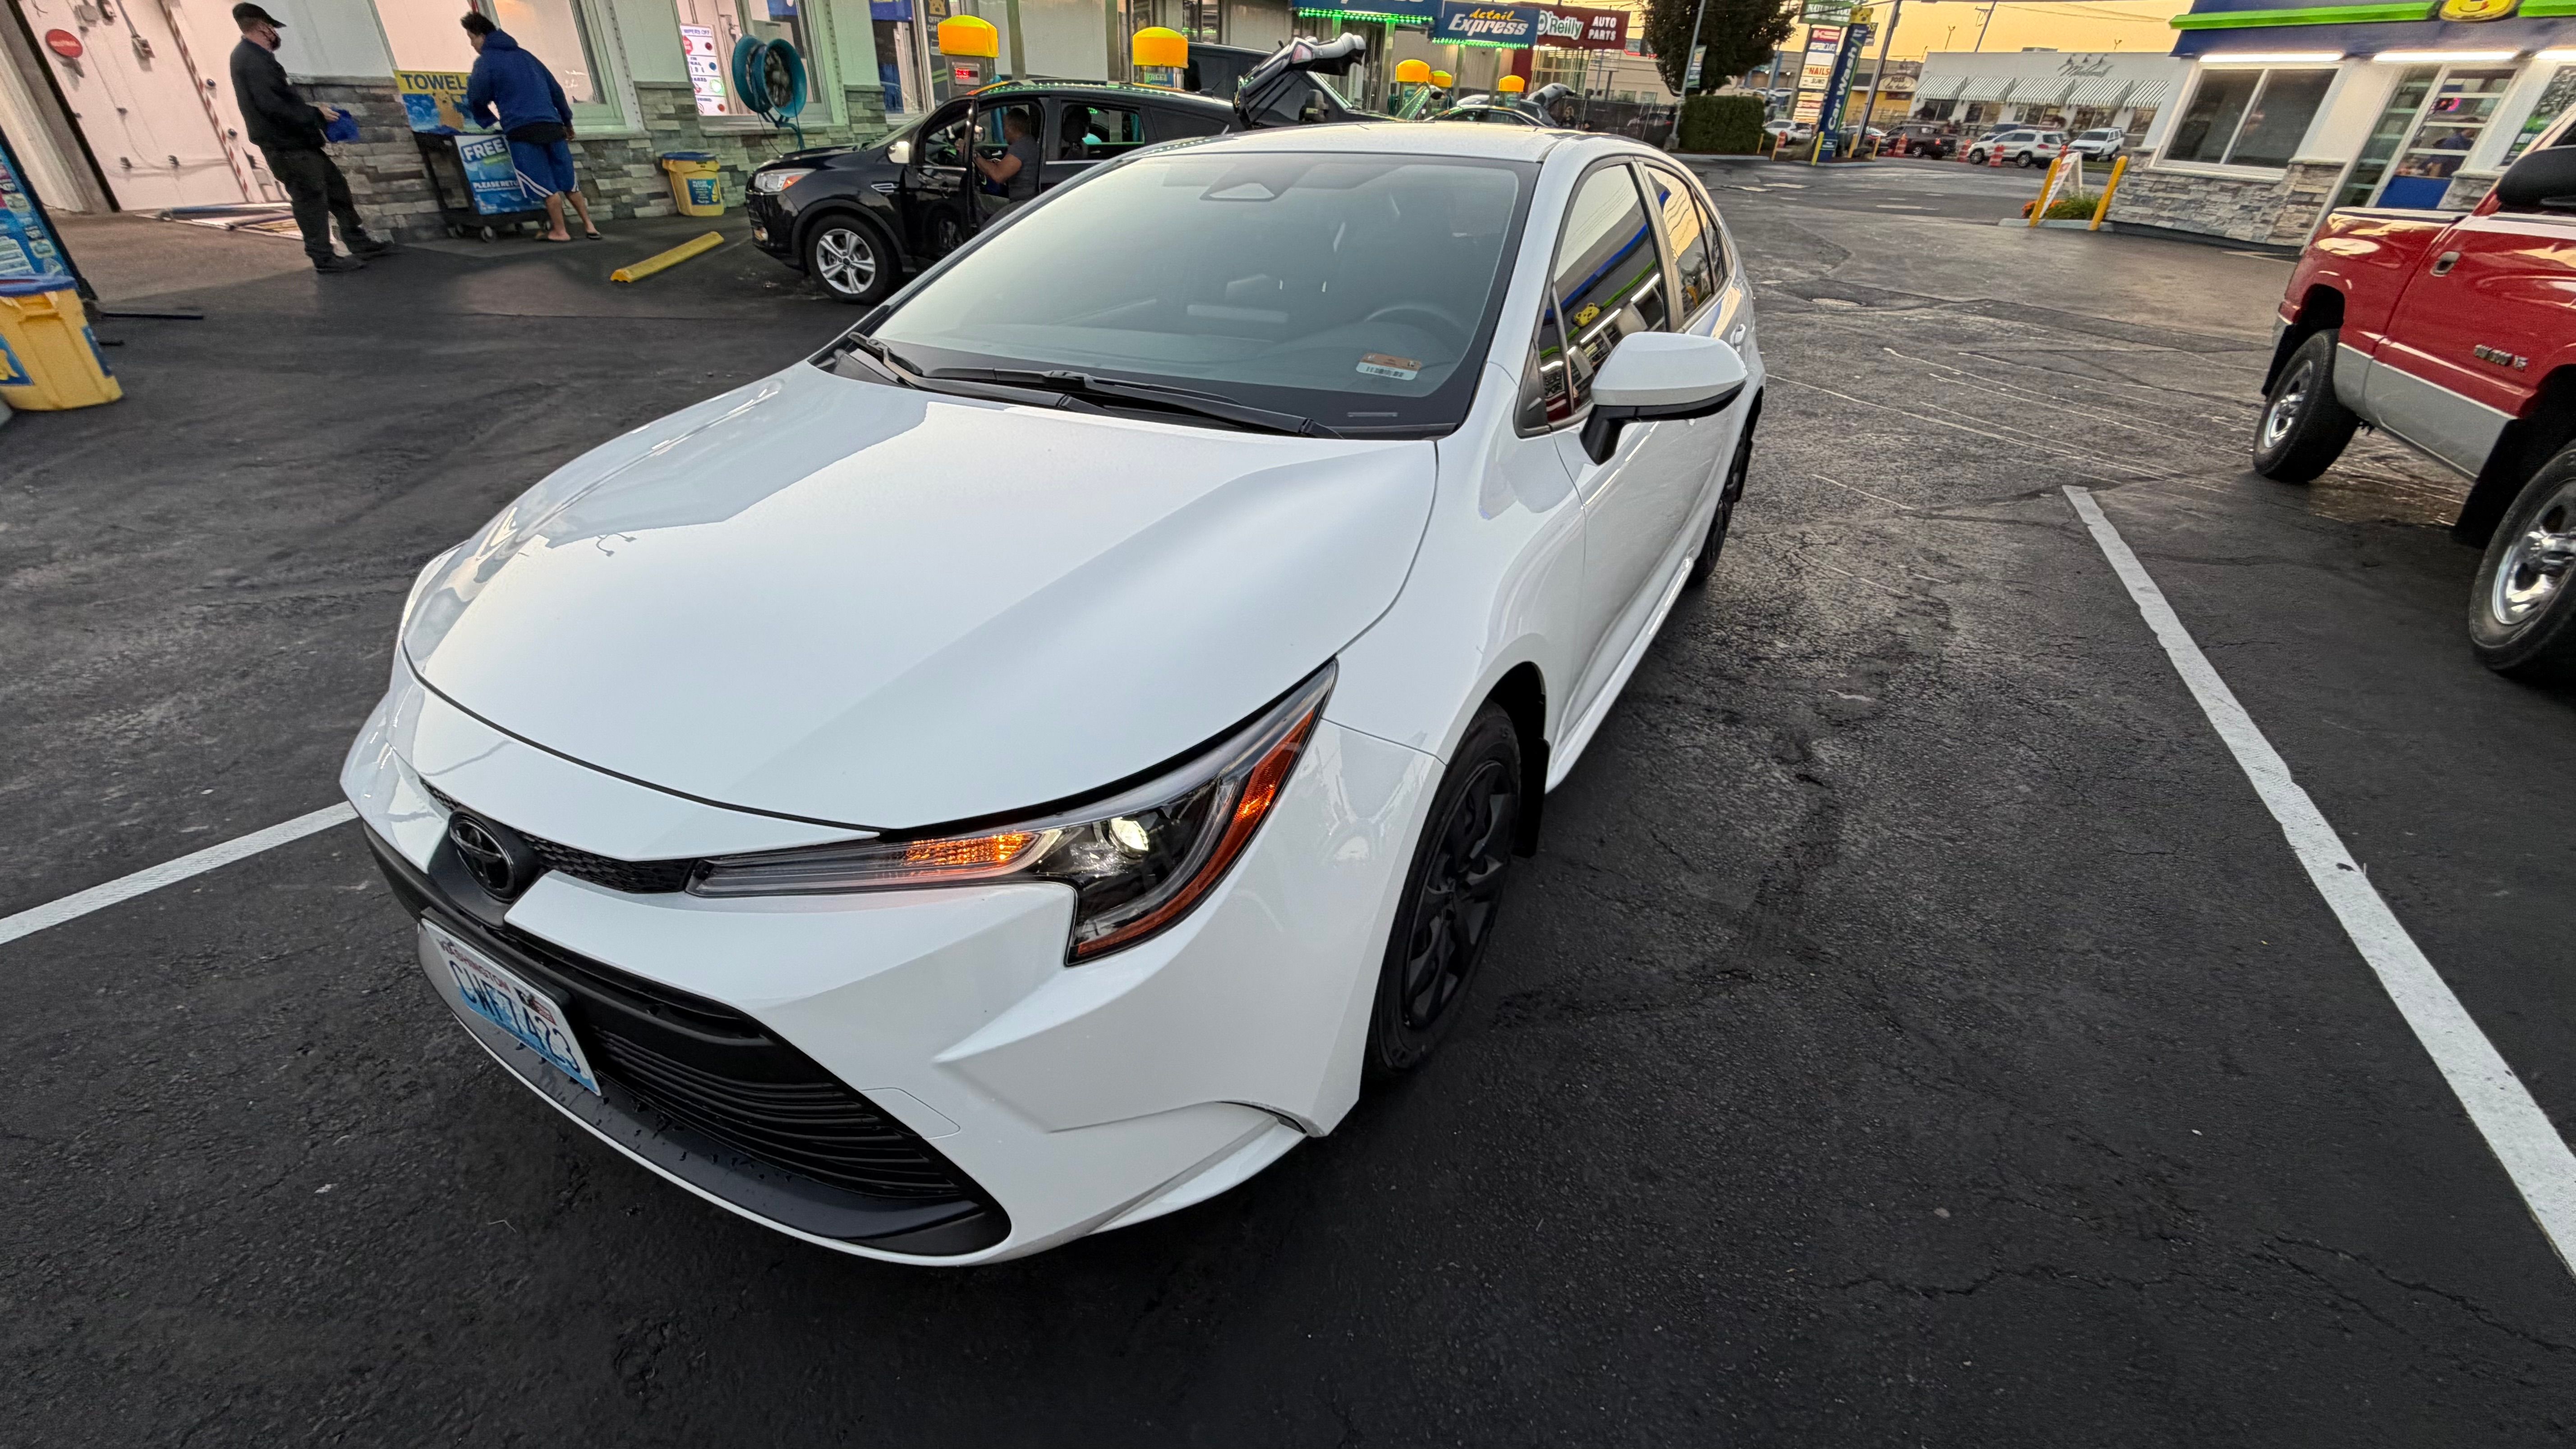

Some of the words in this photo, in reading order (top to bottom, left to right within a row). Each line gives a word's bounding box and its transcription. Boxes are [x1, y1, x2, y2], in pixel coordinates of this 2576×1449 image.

[1448, 14, 1529, 36] Express
[1469, 8, 1527, 23] detail
[1538, 10, 1584, 40] O'Reilly
[1592, 16, 1617, 28] AUTO
[1588, 29, 1616, 41] PARTS
[1808, 67, 1830, 75] NAILS
[400, 74, 468, 90] TOWEL
[1828, 99, 1841, 130] Car
[1836, 46, 1857, 96] Wash
[463, 138, 506, 161] FREE
[449, 960, 581, 1073] CWF7423
